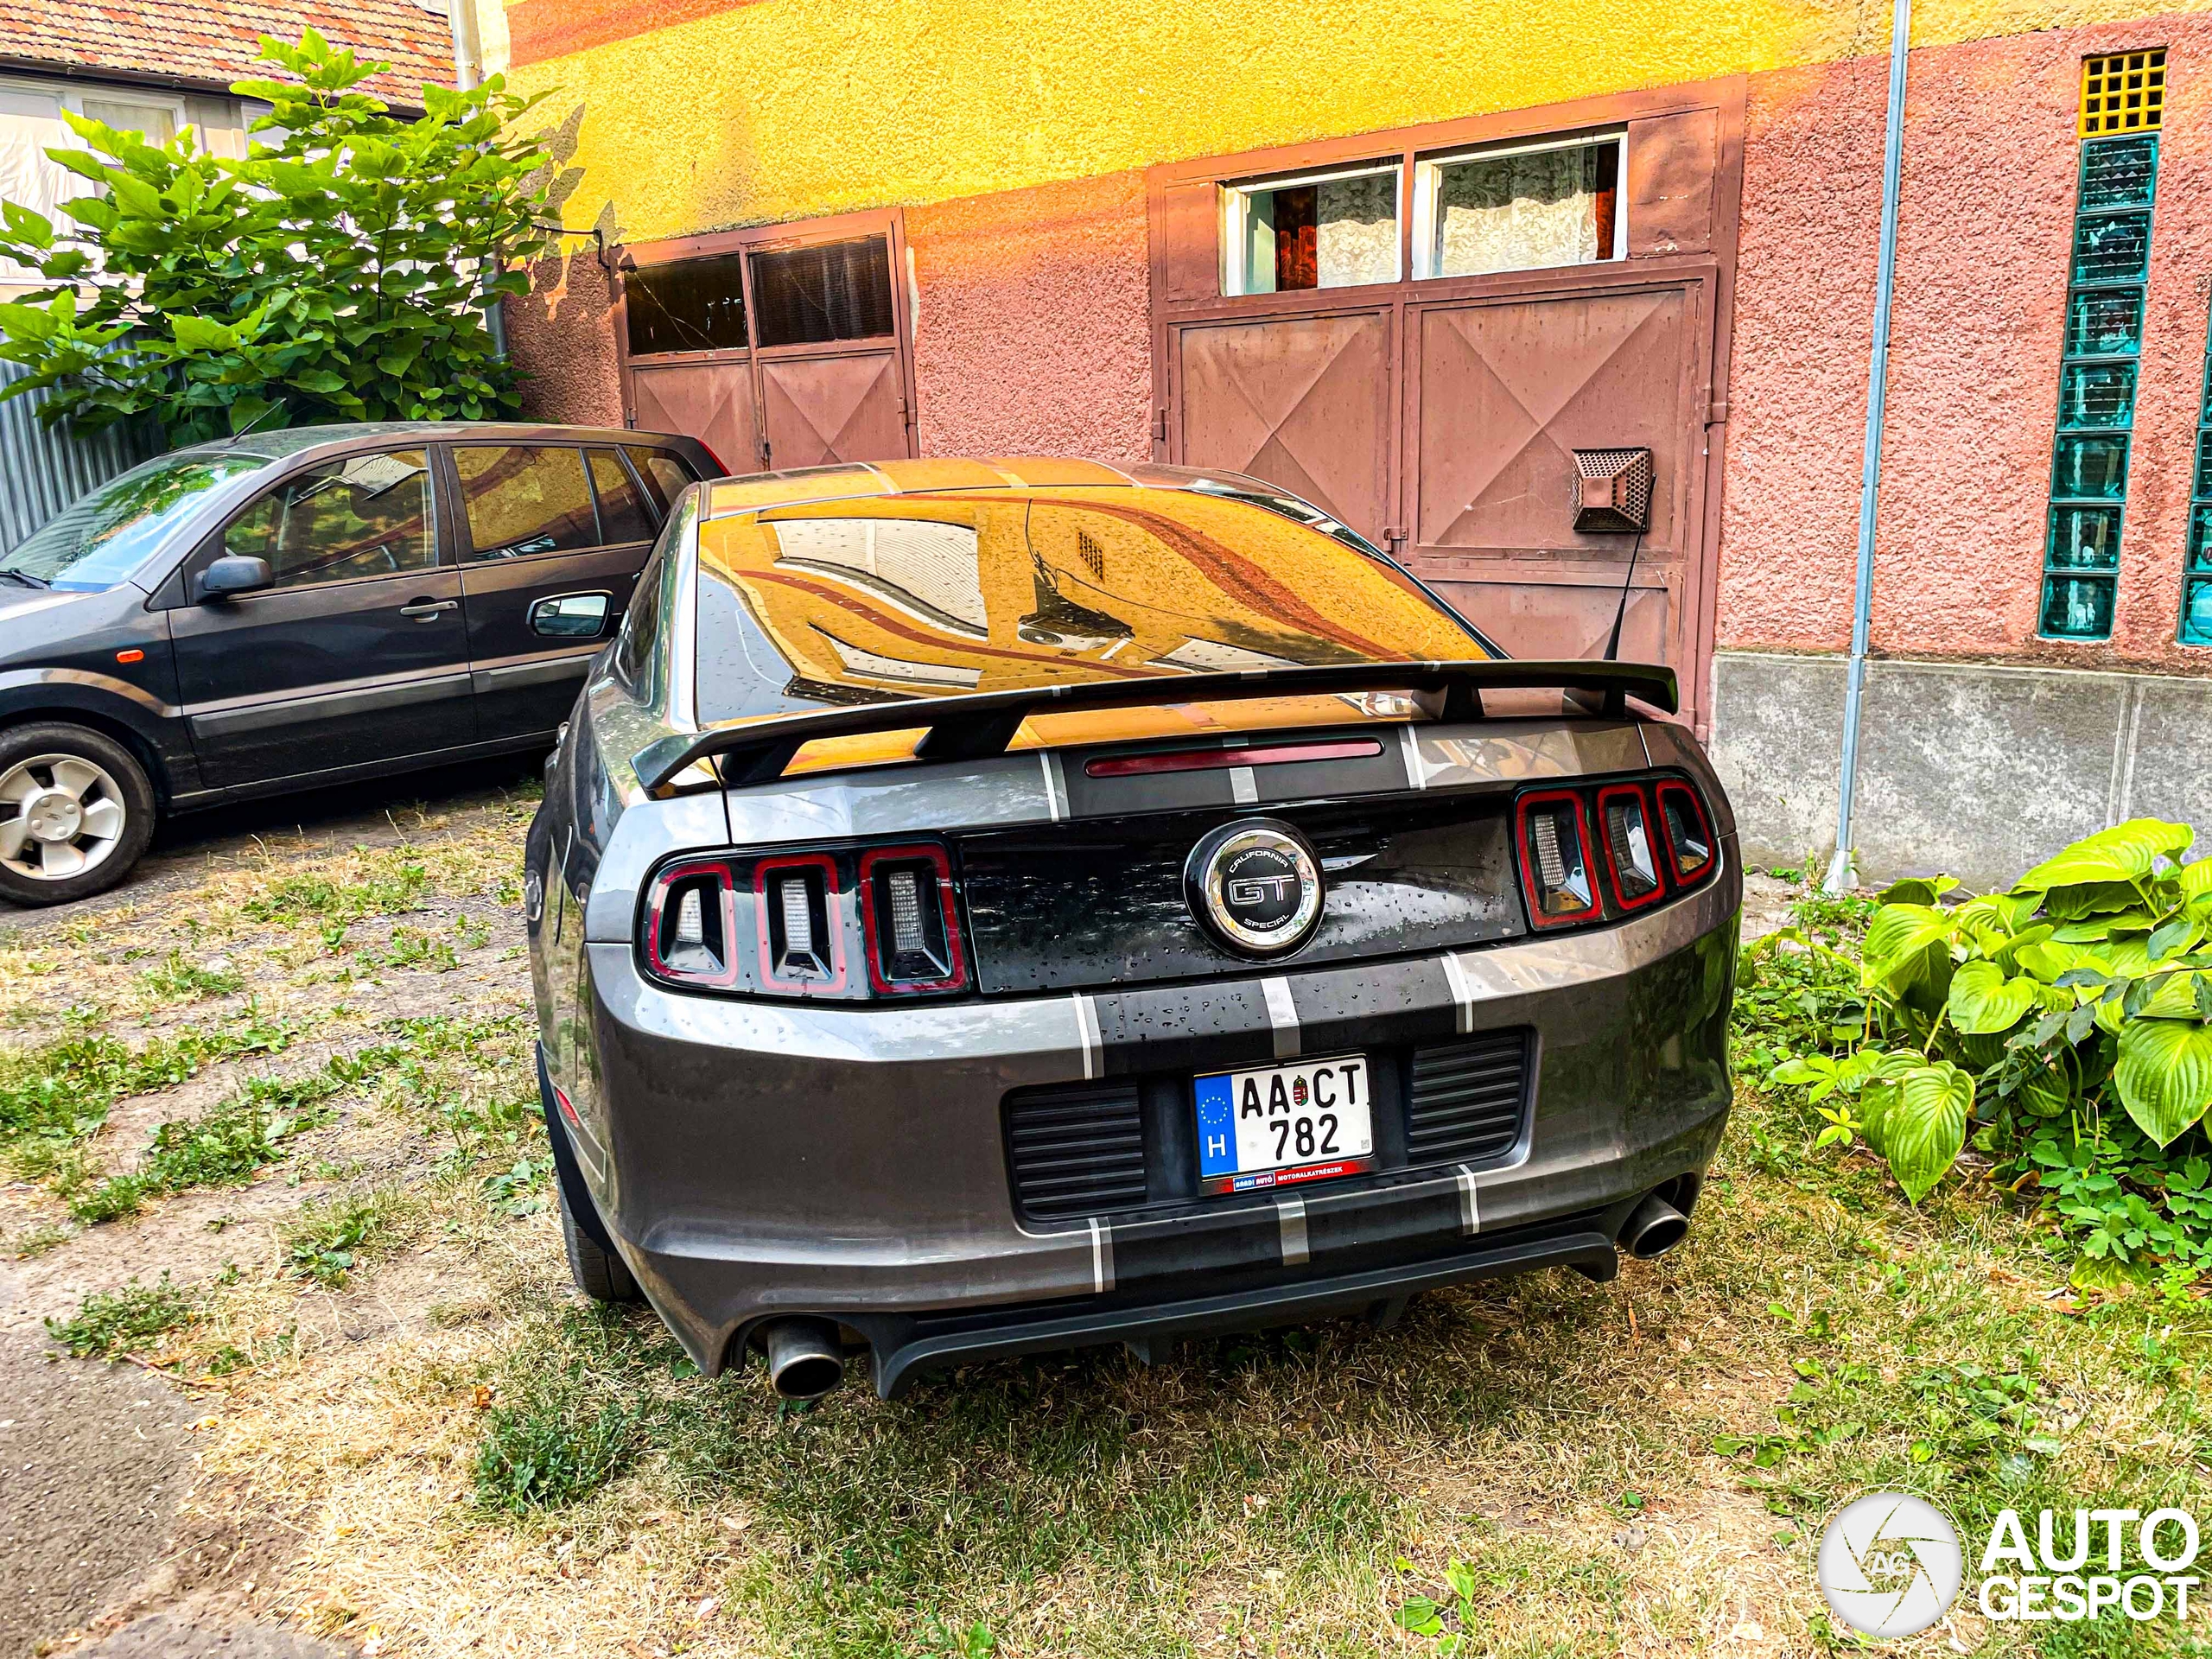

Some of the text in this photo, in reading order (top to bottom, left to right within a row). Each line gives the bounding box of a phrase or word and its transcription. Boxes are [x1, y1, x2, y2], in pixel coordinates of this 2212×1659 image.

[1229, 850, 1288, 874] CALIFORNIA
[1228, 874, 1295, 906] GT
[1243, 913, 1290, 929] SPECIAL
[1207, 1134, 1226, 1158] H
[1269, 1114, 1340, 1160] 782
[1277, 1166, 1343, 1181] MOTORALKATRÉSZEK
